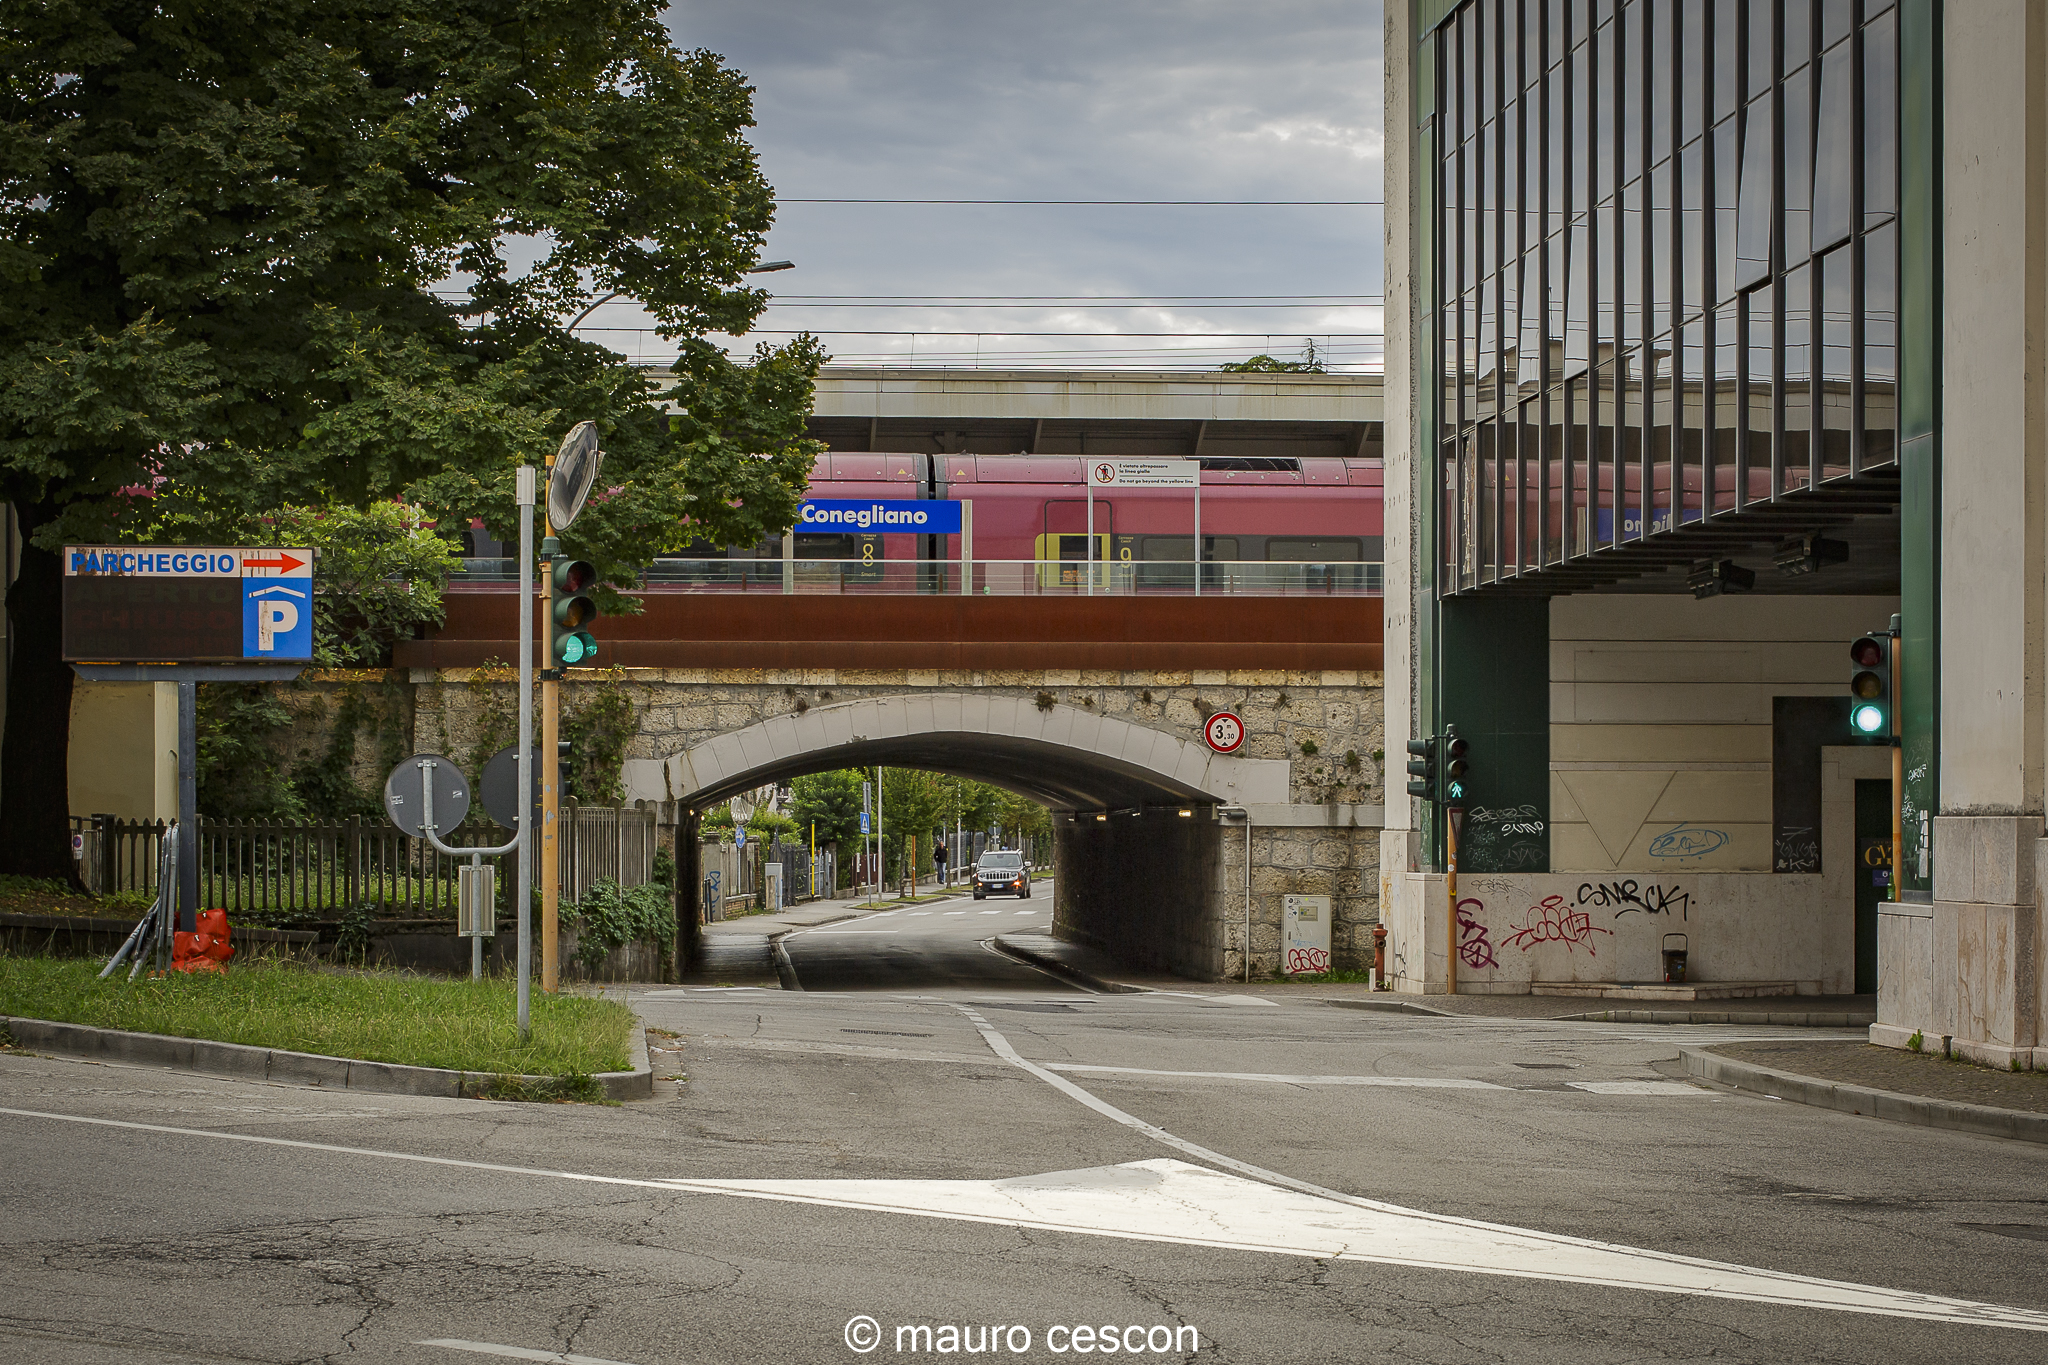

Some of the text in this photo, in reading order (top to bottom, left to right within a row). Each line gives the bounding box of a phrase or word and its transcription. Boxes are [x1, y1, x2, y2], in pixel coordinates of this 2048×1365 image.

[801, 504, 928, 528] Conegliano
[71, 553, 235, 573] PARCHEGGIO
[862, 543, 874, 567] 8
[1120, 547, 1132, 568] 9
[71, 583, 235, 602] APERTO
[71, 610, 235, 629] CHIUSO
[258, 600, 299, 651] P
